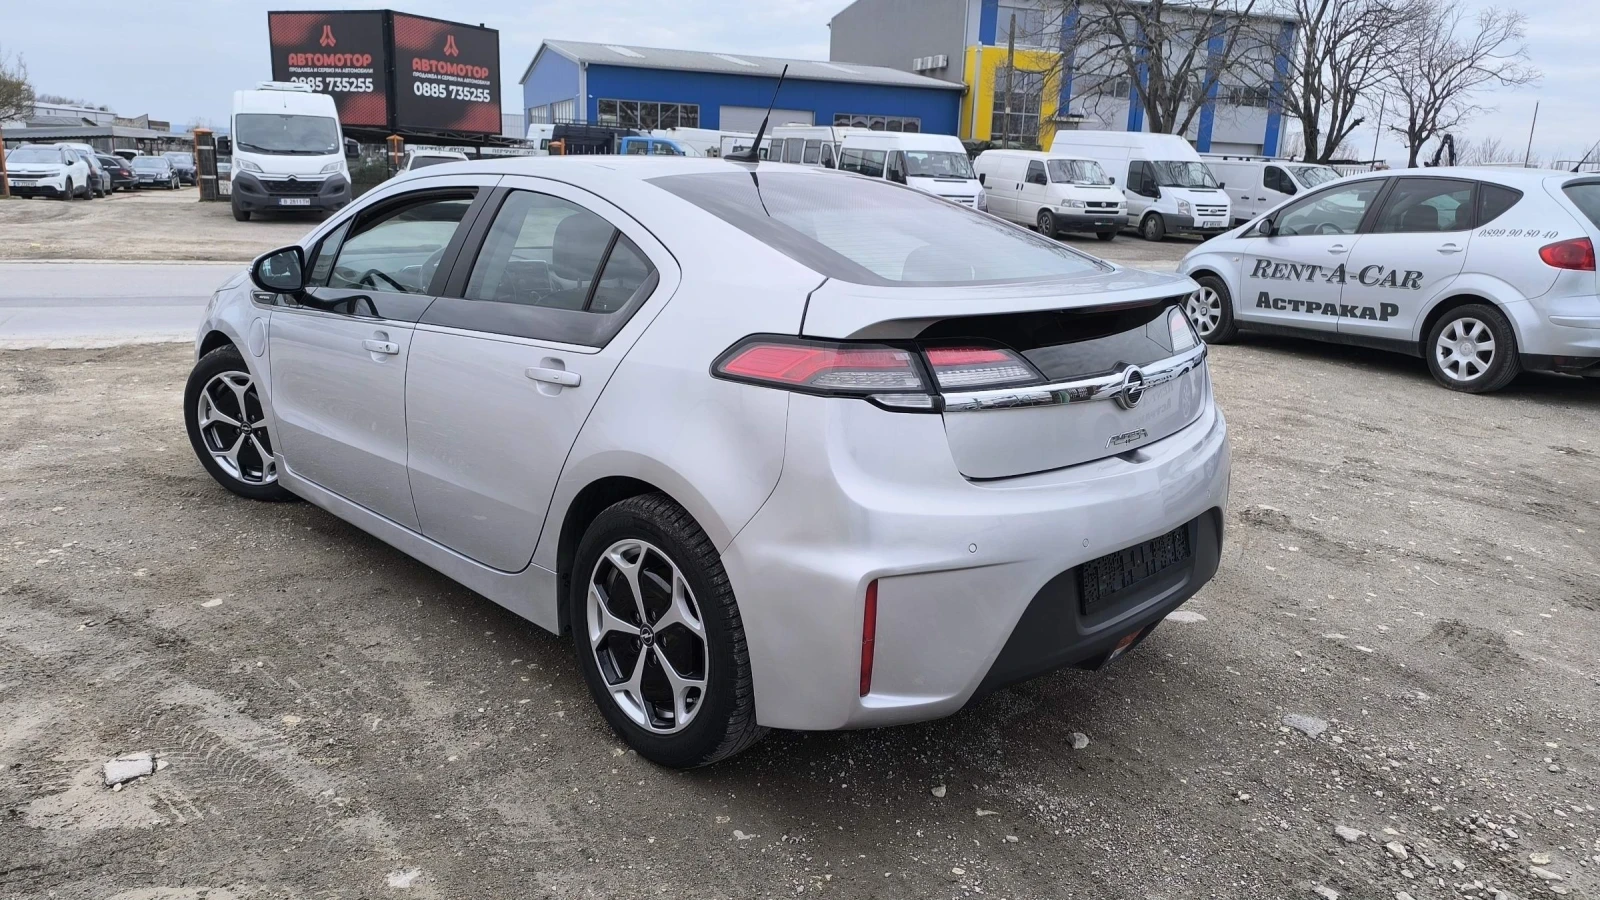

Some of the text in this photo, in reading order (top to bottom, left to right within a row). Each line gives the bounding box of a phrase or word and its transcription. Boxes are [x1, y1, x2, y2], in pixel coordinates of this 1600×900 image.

[288, 53, 372, 67] АВТОМОТОР
[412, 57, 489, 79] АВТОМОТОР
[412, 71, 438, 79] ПРОДАЖБА
[326, 77, 374, 92] 735255
[413, 81, 491, 103] 0885 735255
[1478, 228, 1559, 239] 0899 90 80 40
[1250, 258, 1425, 291] RENT-A-CAR
